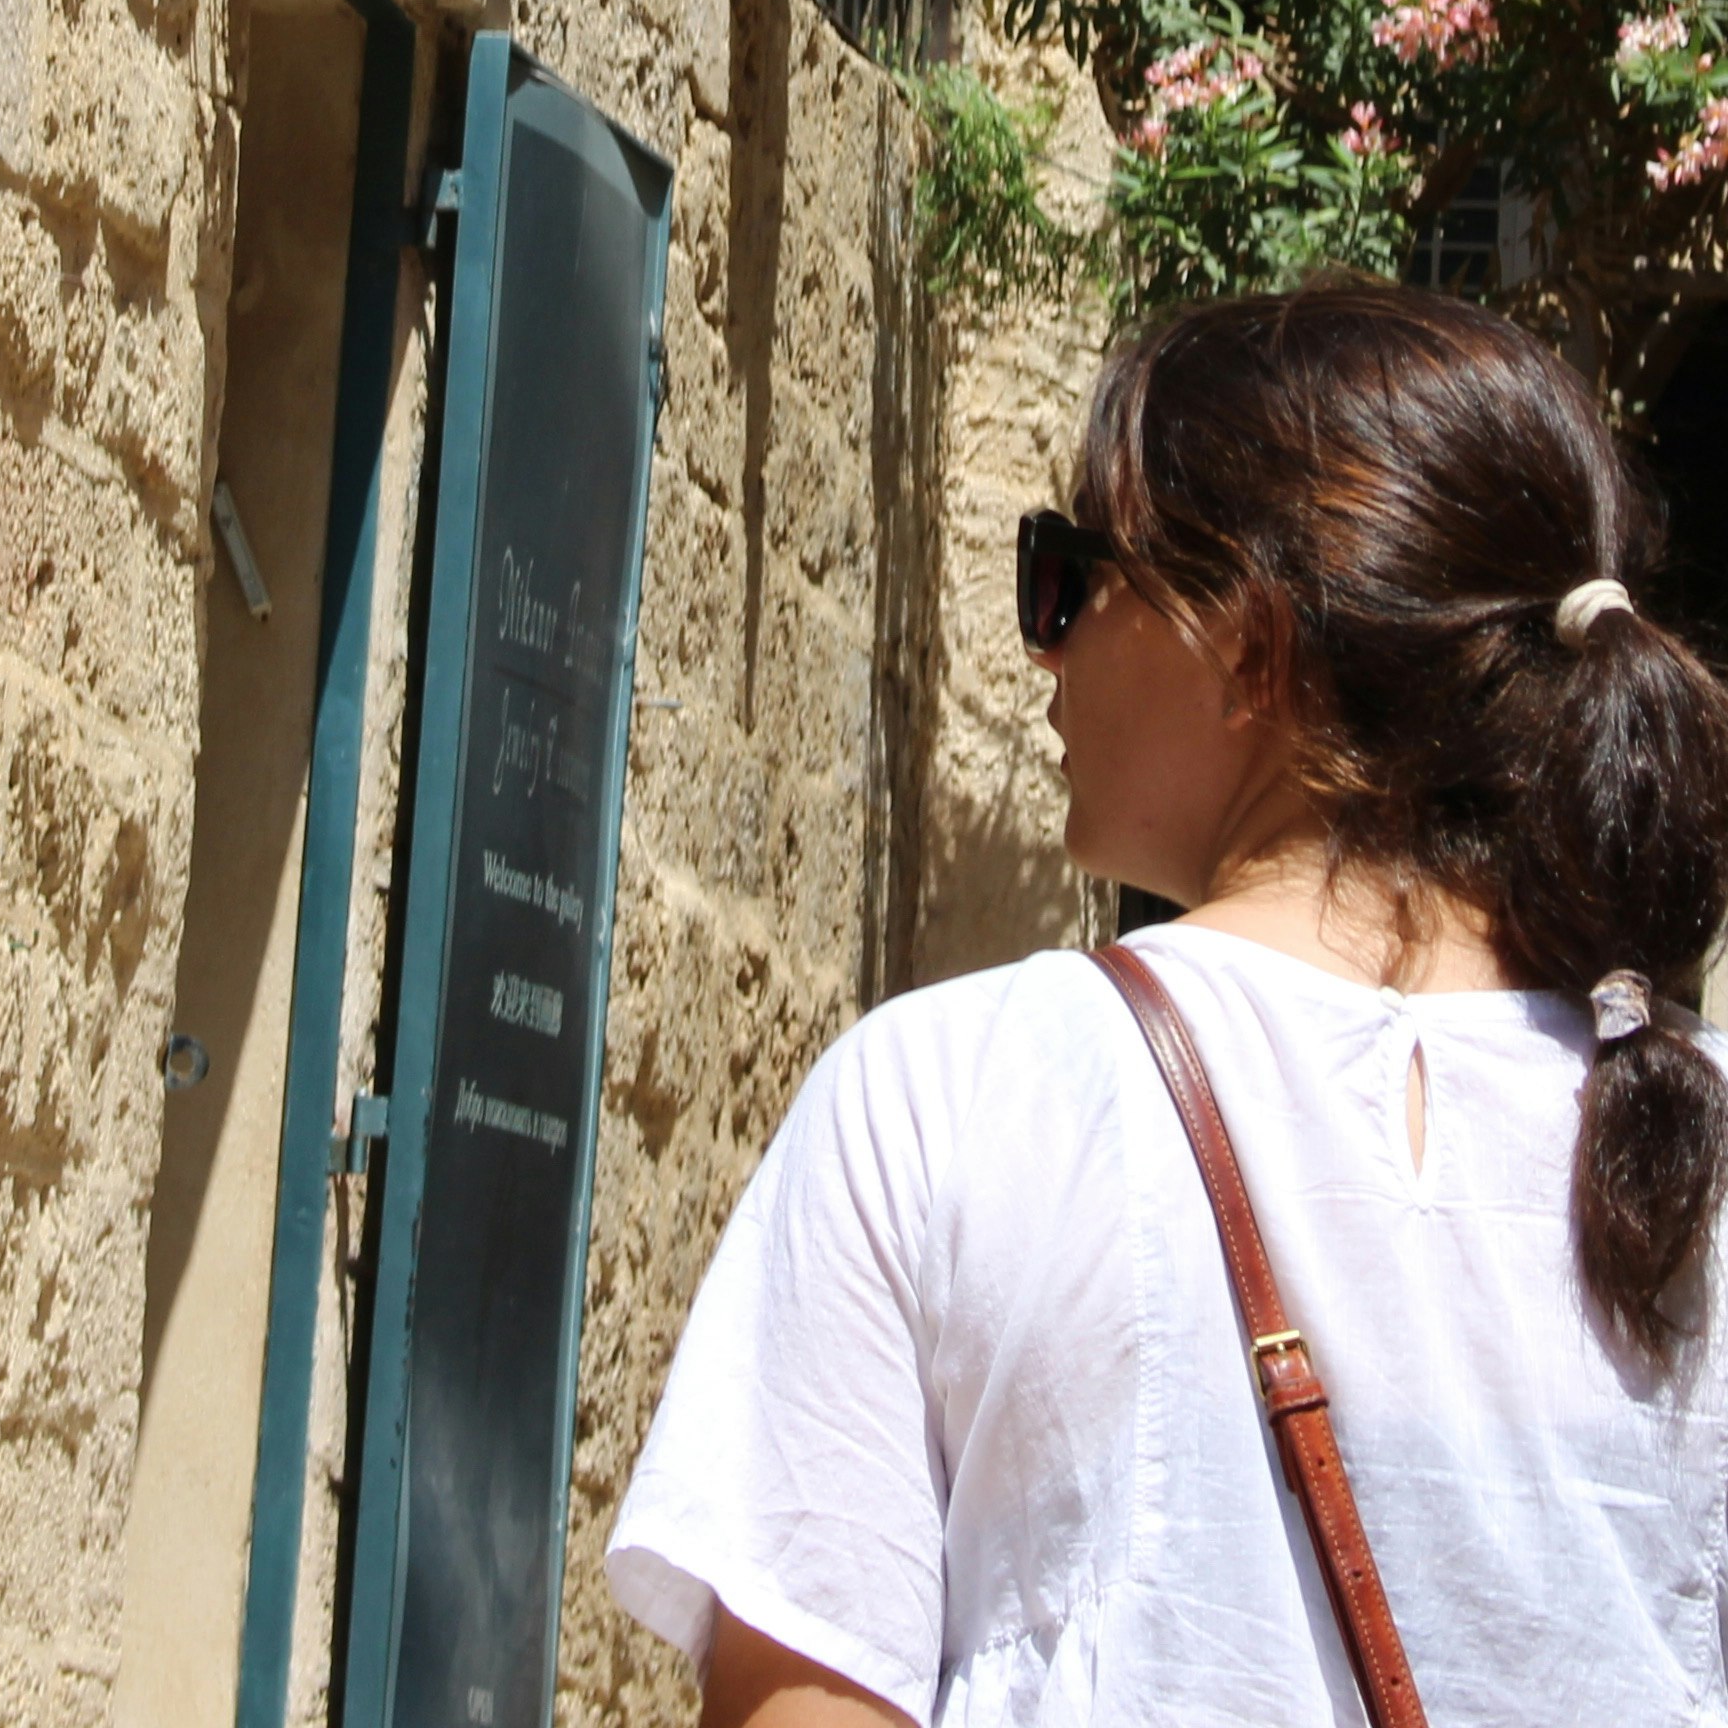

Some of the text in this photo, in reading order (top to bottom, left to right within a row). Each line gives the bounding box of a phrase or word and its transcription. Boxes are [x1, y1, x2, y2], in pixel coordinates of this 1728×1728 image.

[483, 849, 531, 903] Welcome
[532, 873, 544, 907] to
[545, 873, 560, 913] the
